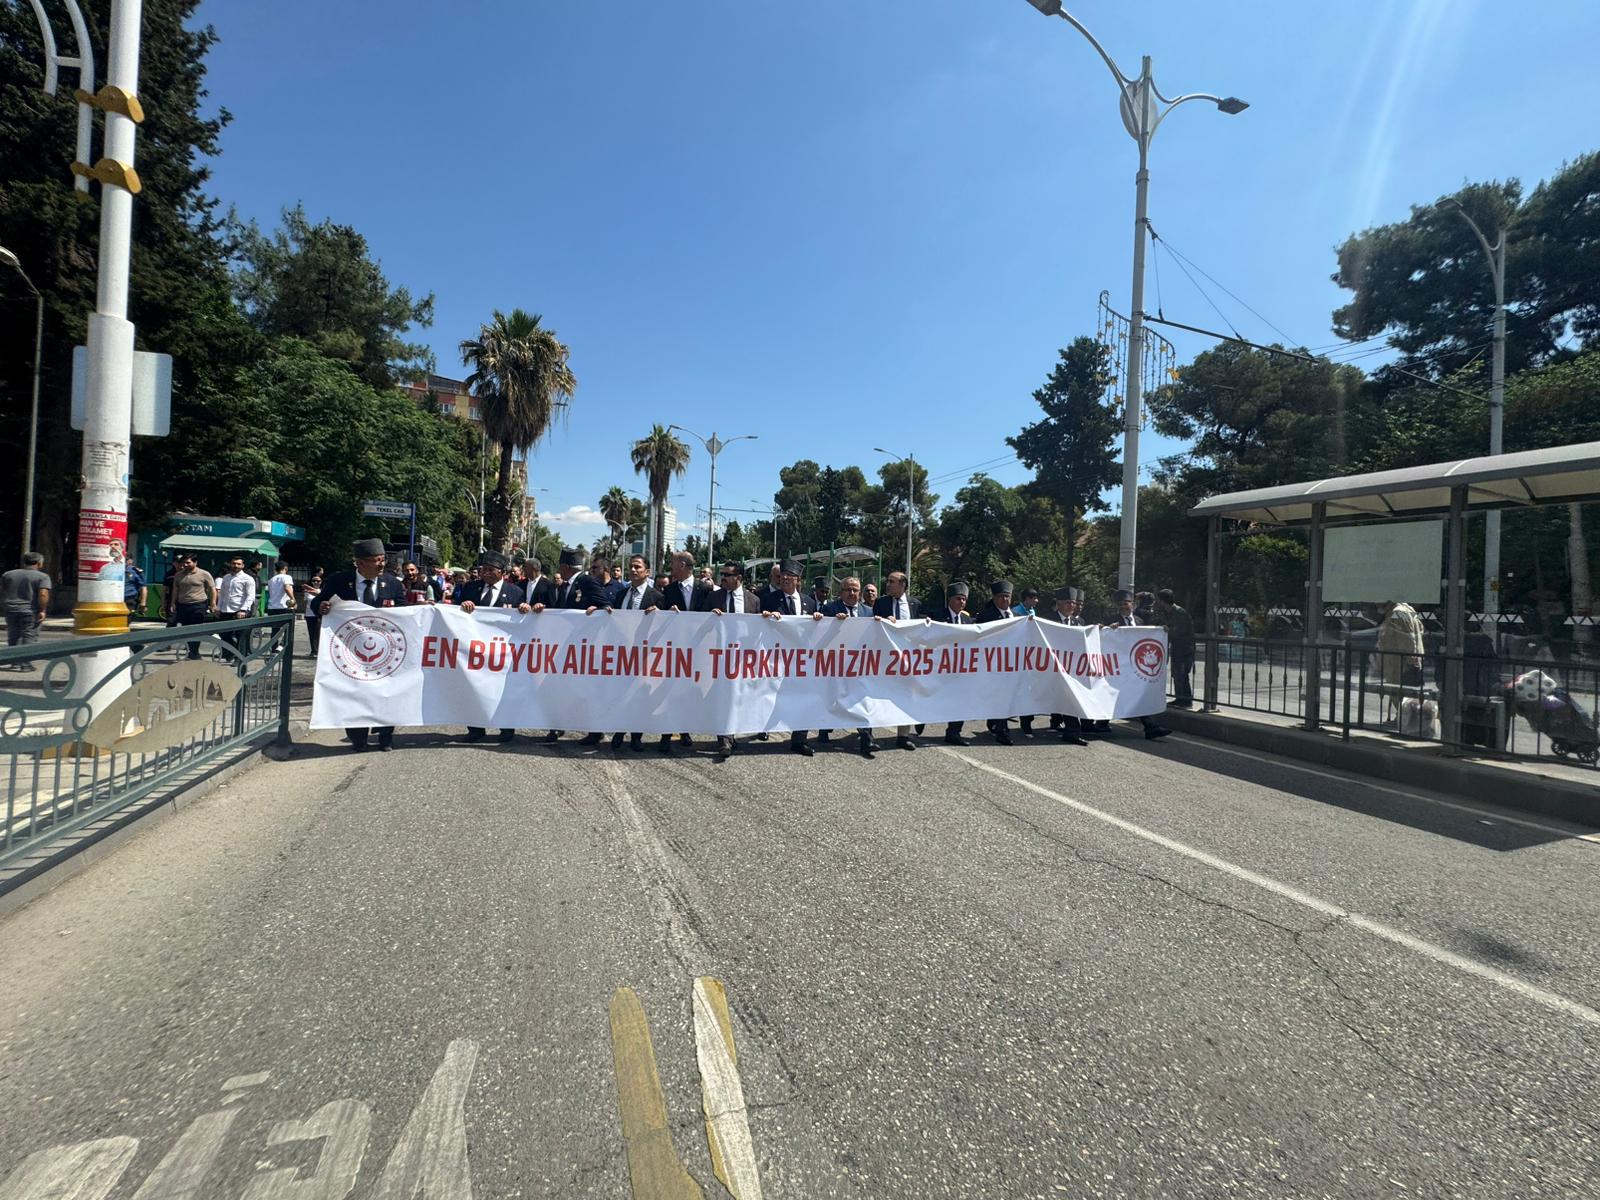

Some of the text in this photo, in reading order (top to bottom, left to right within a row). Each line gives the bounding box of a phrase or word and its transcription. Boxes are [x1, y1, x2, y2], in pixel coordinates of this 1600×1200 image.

[421, 636, 459, 669] EN
[467, 638, 558, 673] BÜYÜK
[563, 640, 701, 682] AİLEMİZİN,
[708, 644, 881, 679] TÜRKİYE'MİZİN
[885, 648, 933, 677] 2025
[938, 643, 979, 673] AİLE
[985, 647, 1020, 673] YILI
